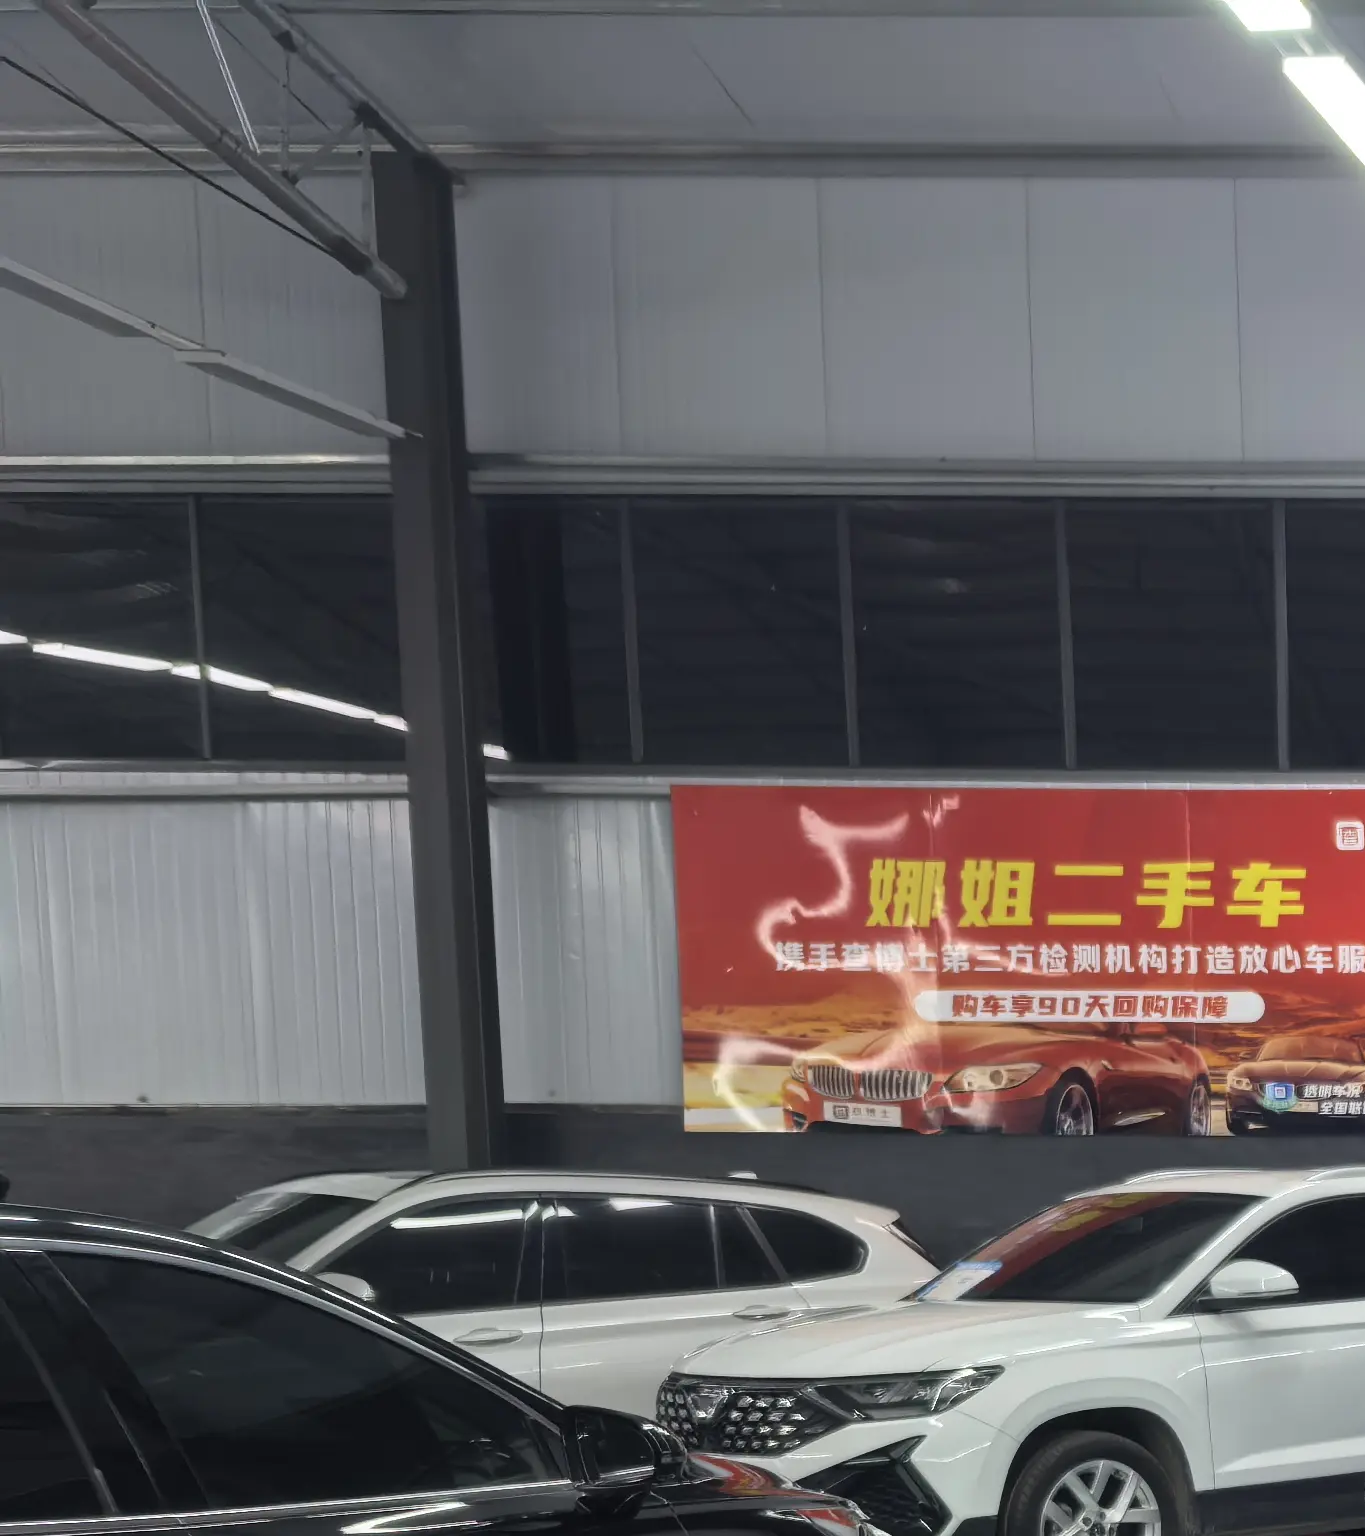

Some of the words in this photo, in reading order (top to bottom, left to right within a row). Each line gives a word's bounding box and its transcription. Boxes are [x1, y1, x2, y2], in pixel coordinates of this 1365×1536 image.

[865, 857, 1307, 928] 娜姐二手车
[952, 993, 1229, 1019] 购车享90天回购保障
